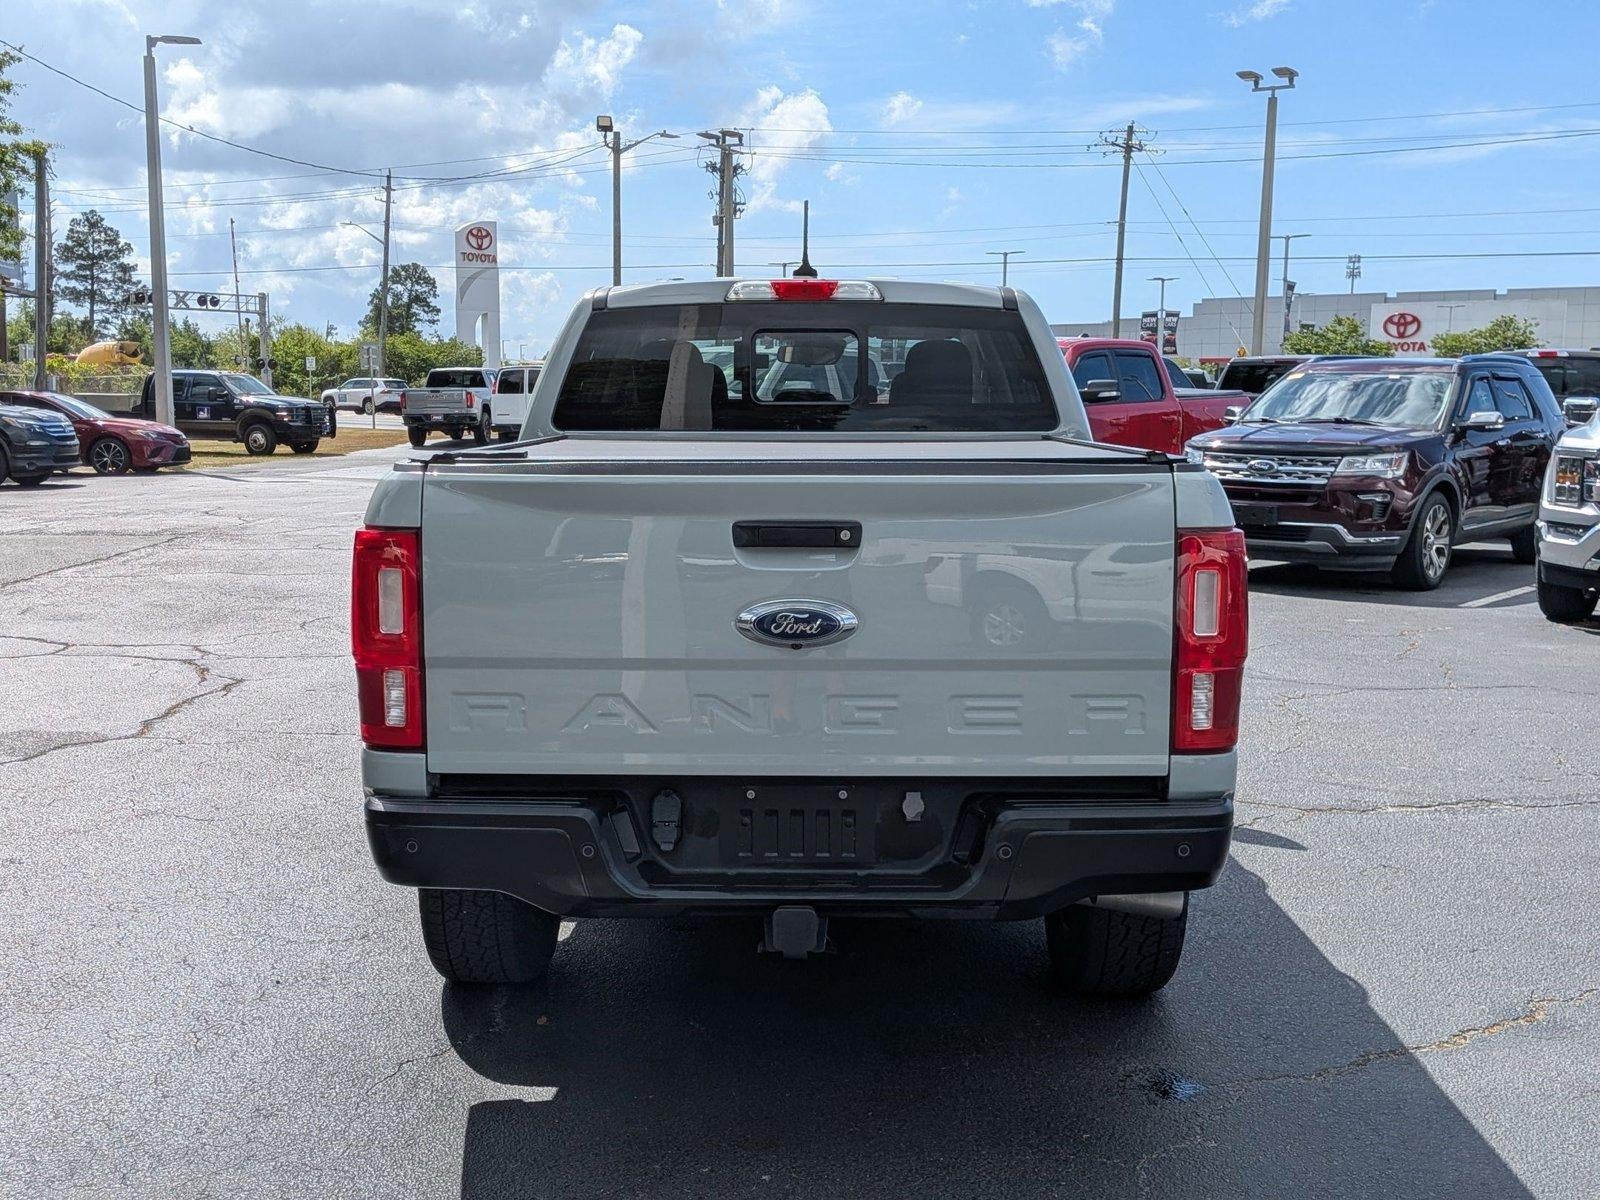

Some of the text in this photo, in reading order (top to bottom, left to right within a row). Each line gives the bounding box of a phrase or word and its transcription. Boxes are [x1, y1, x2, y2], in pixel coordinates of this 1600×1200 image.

[460, 252, 497, 264] TOYOTA
[1391, 341, 1427, 352] YOTA
[771, 612, 822, 634] Ford
[450, 691, 1146, 736] RANGER
